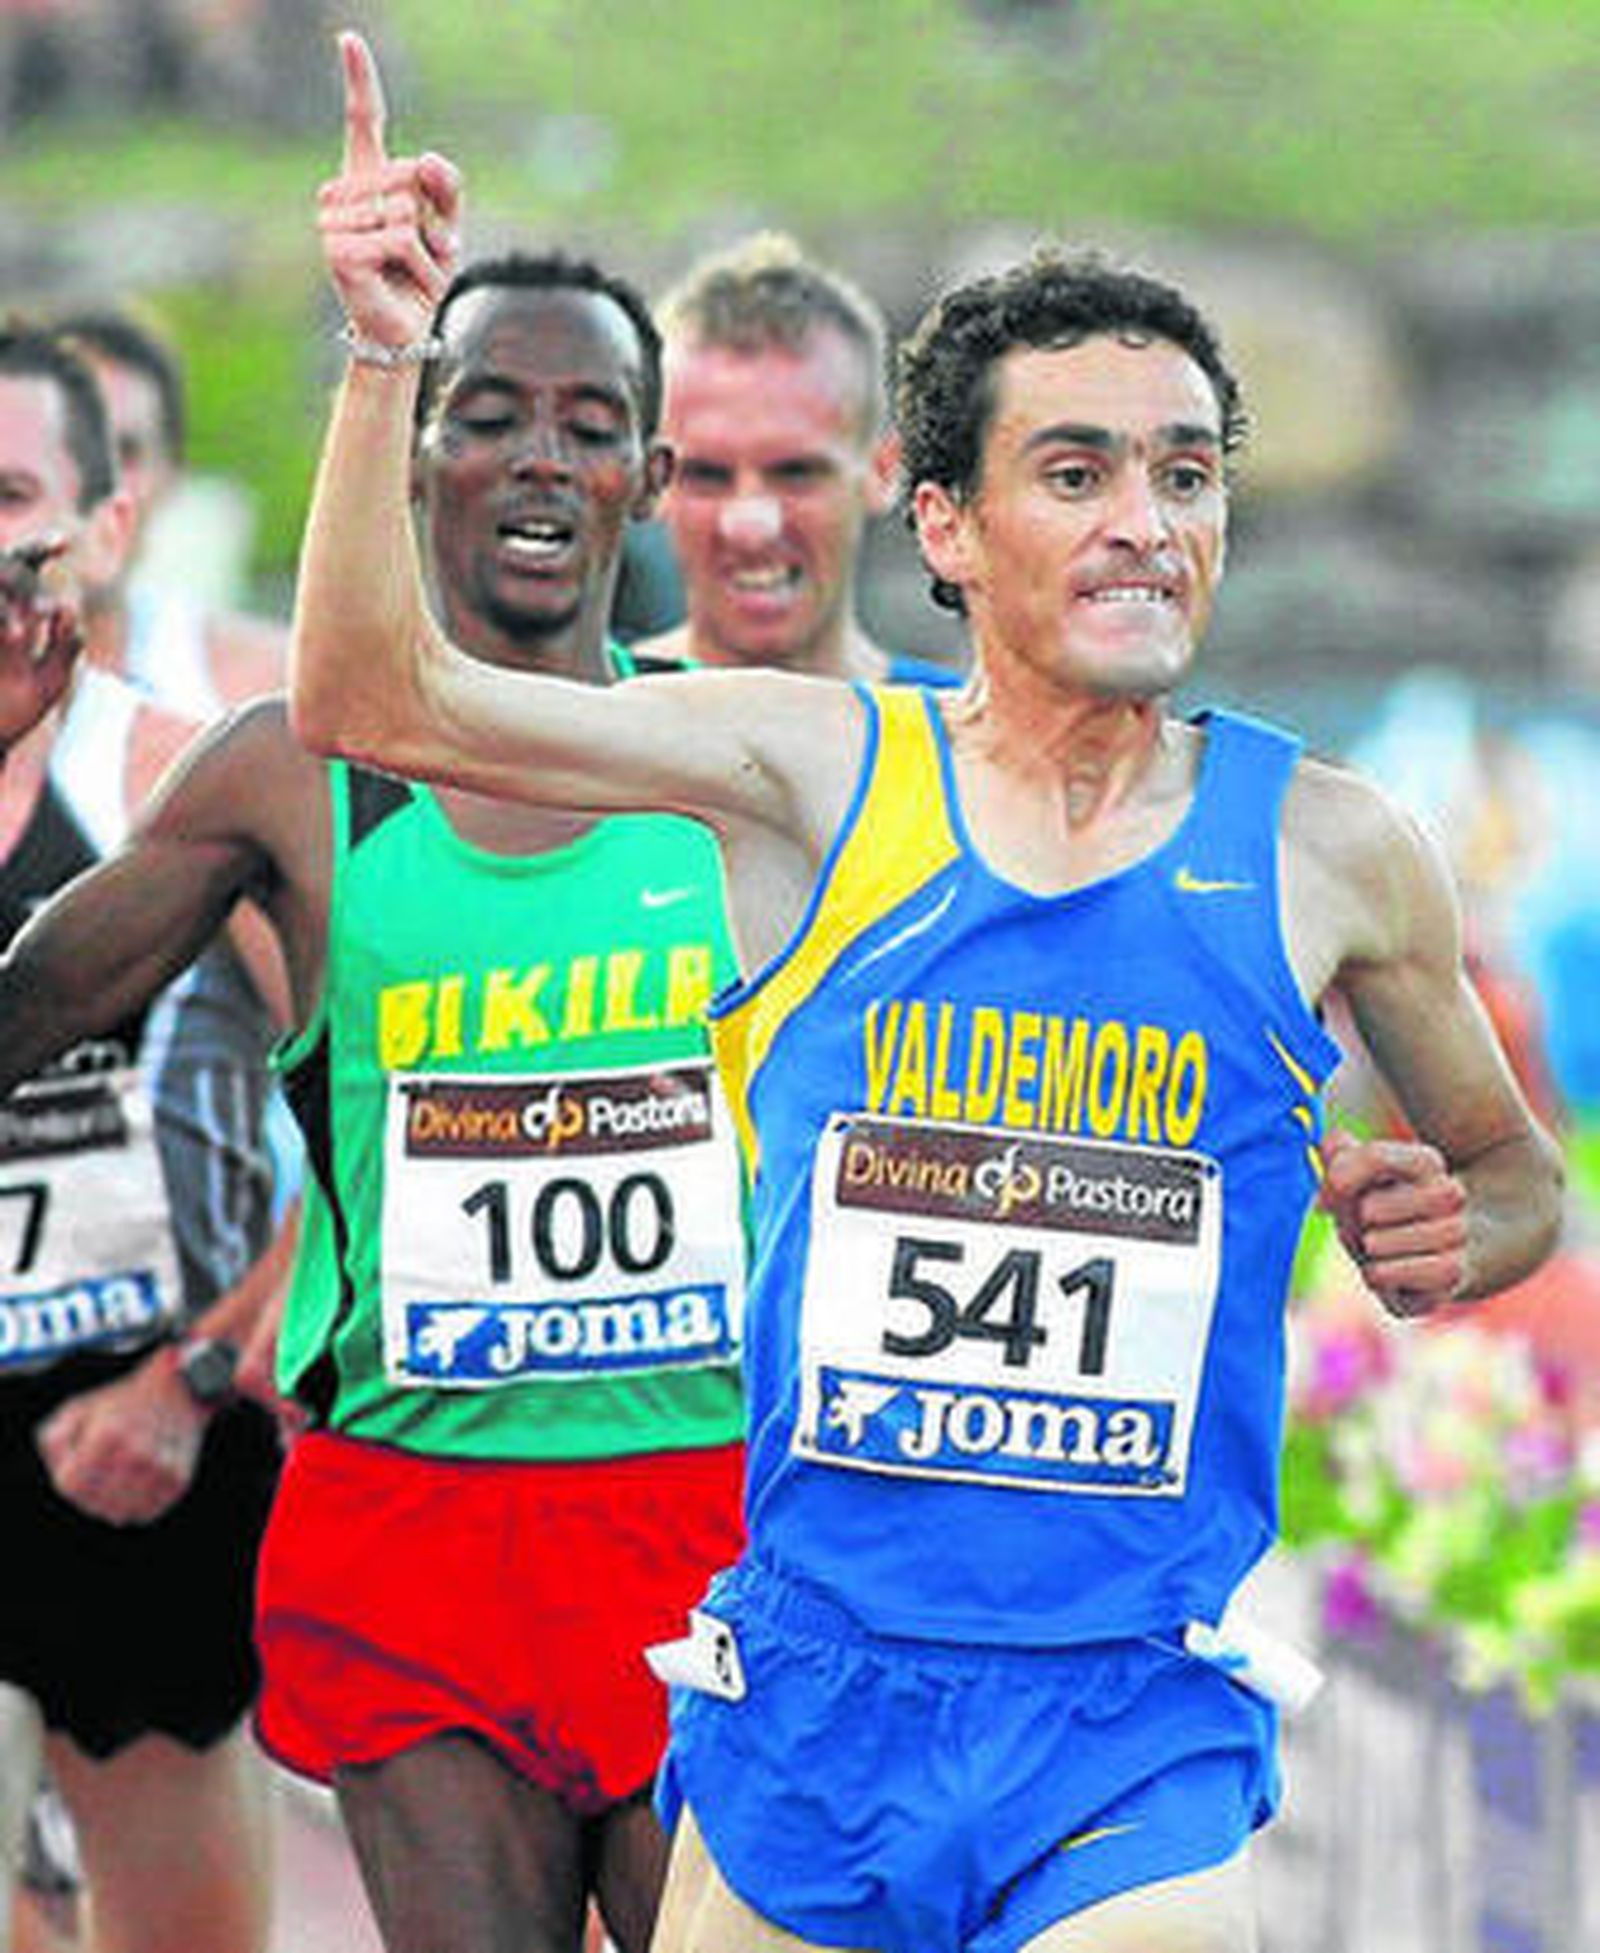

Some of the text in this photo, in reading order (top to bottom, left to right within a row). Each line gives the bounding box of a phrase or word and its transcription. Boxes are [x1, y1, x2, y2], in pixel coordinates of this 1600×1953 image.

[379, 946, 711, 1069] BIKILA
[411, 1099, 518, 1141] Divina
[865, 1000, 1208, 1146] VALDEMORO
[461, 1172, 675, 1284] 100
[845, 1143, 967, 1197] Divina
[1044, 1165, 1194, 1220] Pastora
[881, 1236, 1115, 1376] 541
